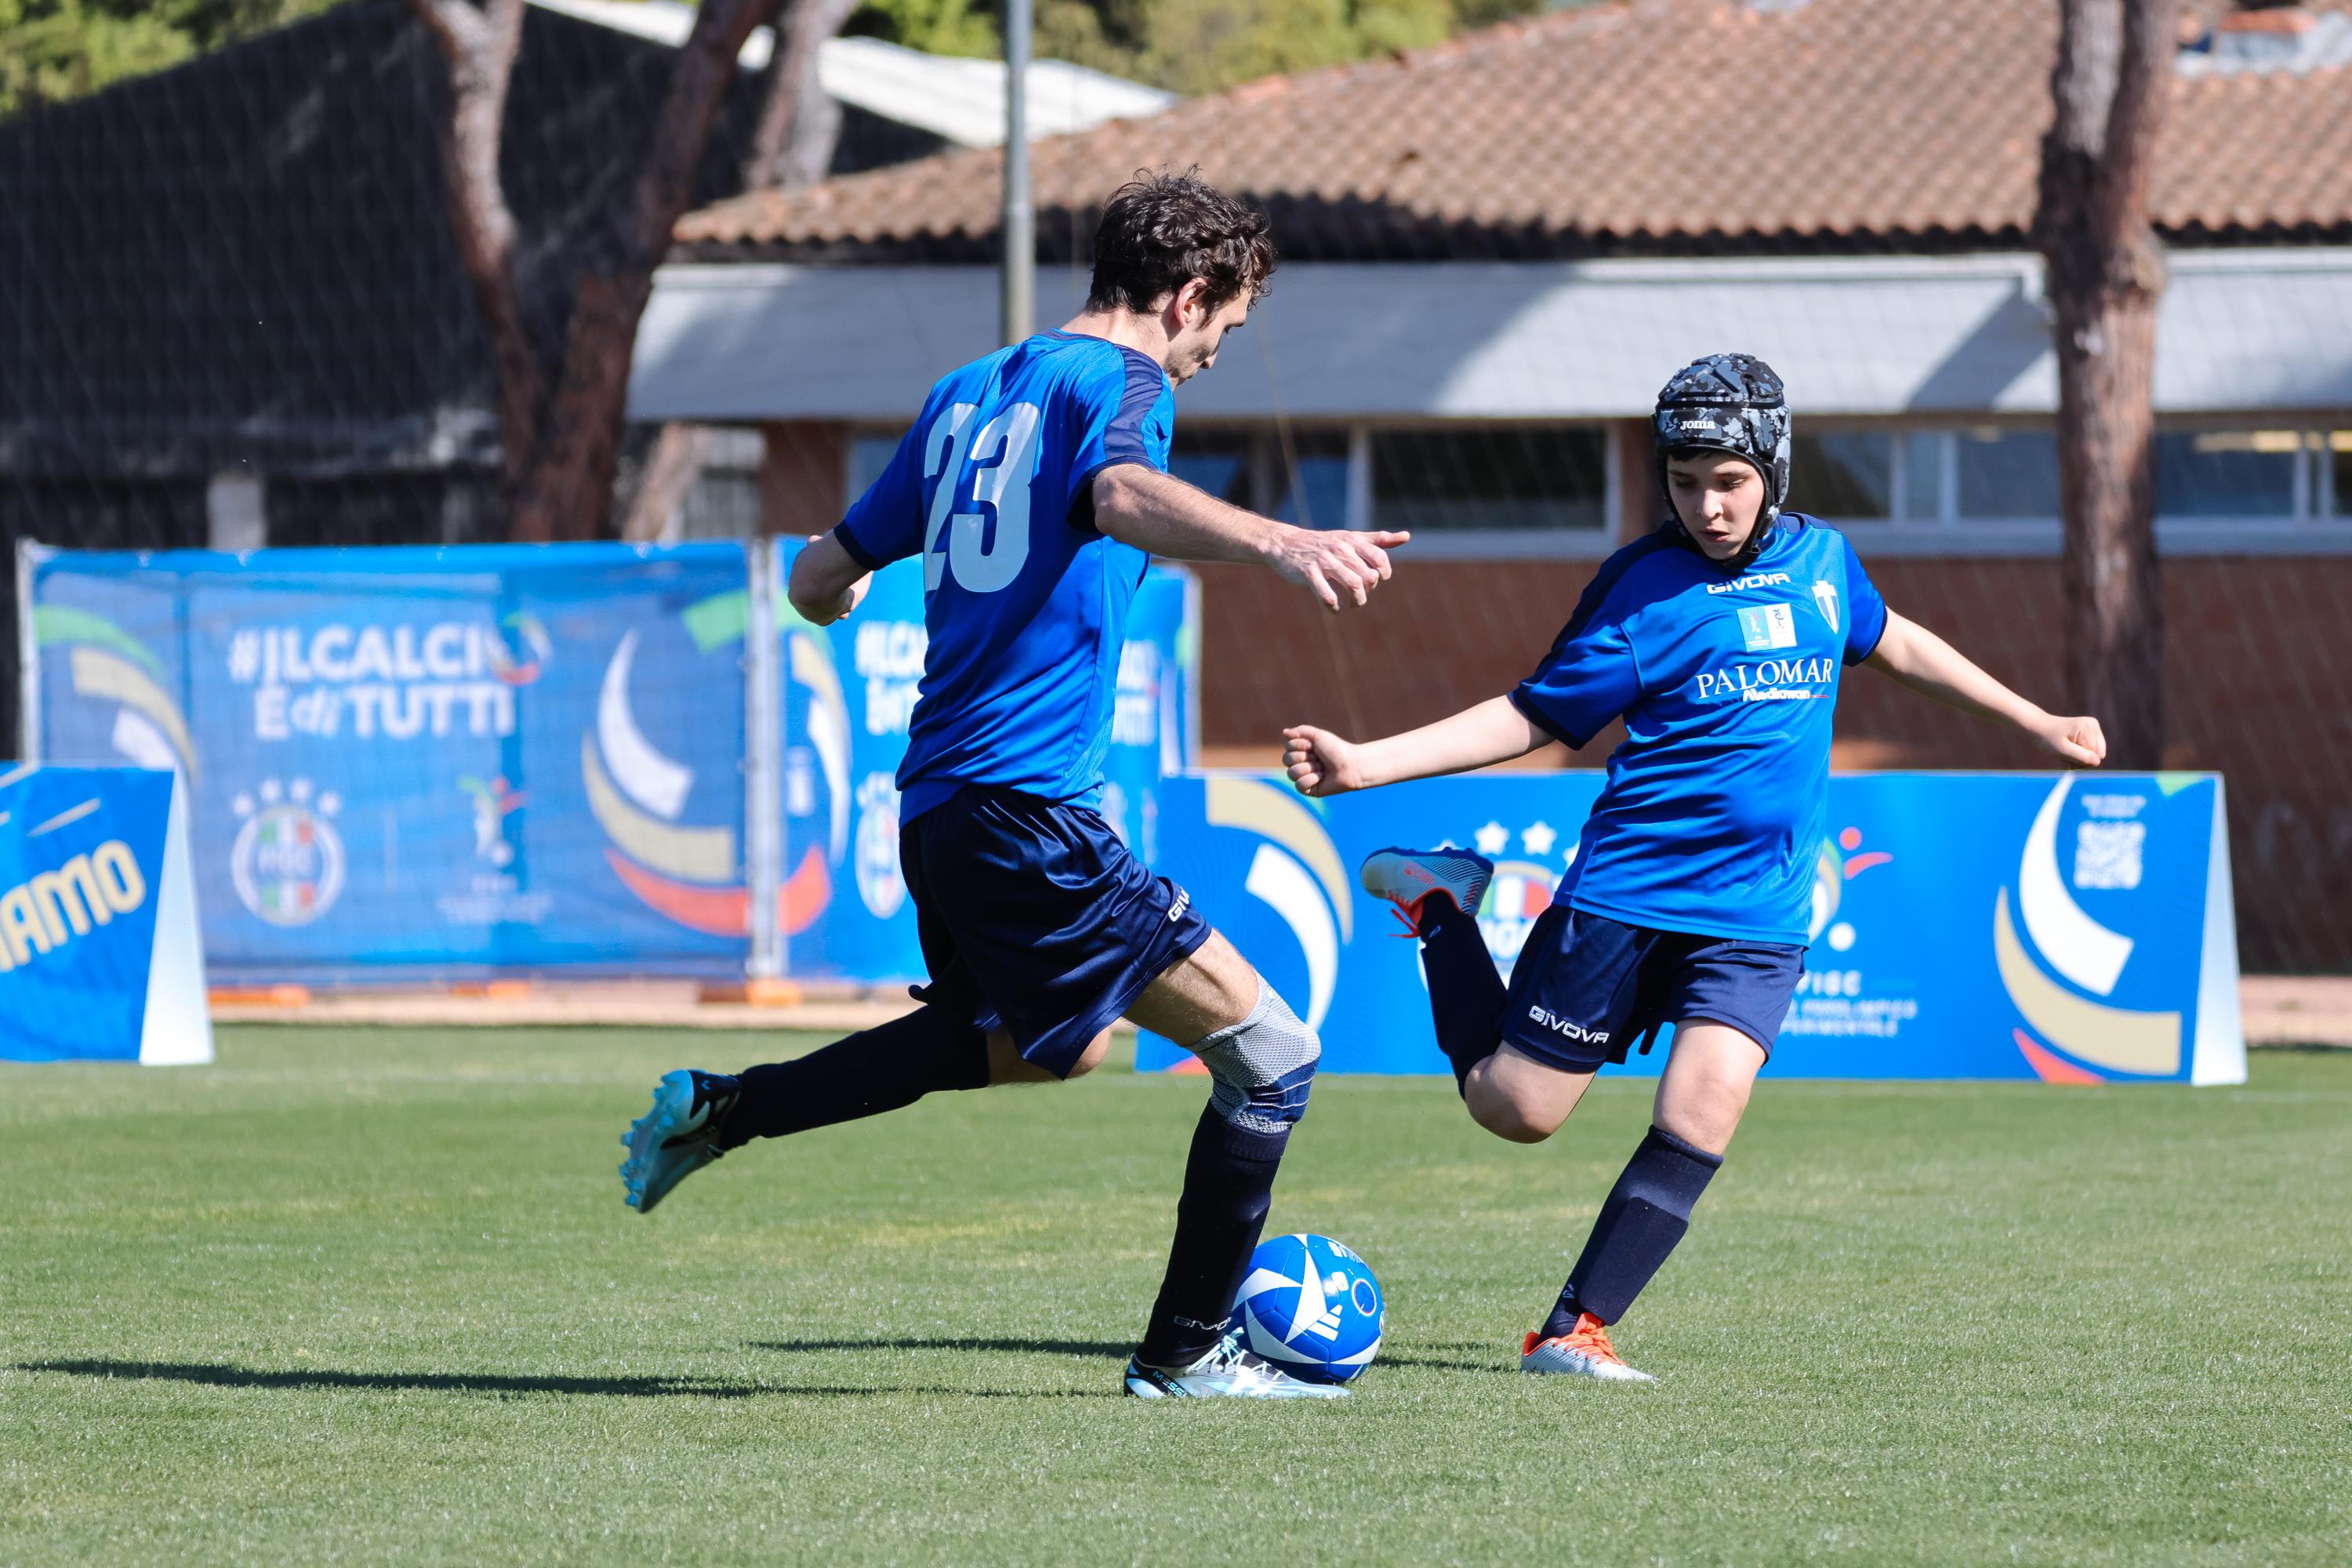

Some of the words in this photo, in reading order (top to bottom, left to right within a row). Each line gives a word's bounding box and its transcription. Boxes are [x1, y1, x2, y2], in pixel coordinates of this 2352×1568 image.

[924, 401, 1041, 593] 23
[1707, 572, 1791, 594] GIVOVA
[1695, 658, 1834, 699] PALOMAR
[347, 681, 516, 739] TUTTI
[1167, 885, 1190, 922] GIV
[1529, 1005, 1610, 1044] GIVOVA
